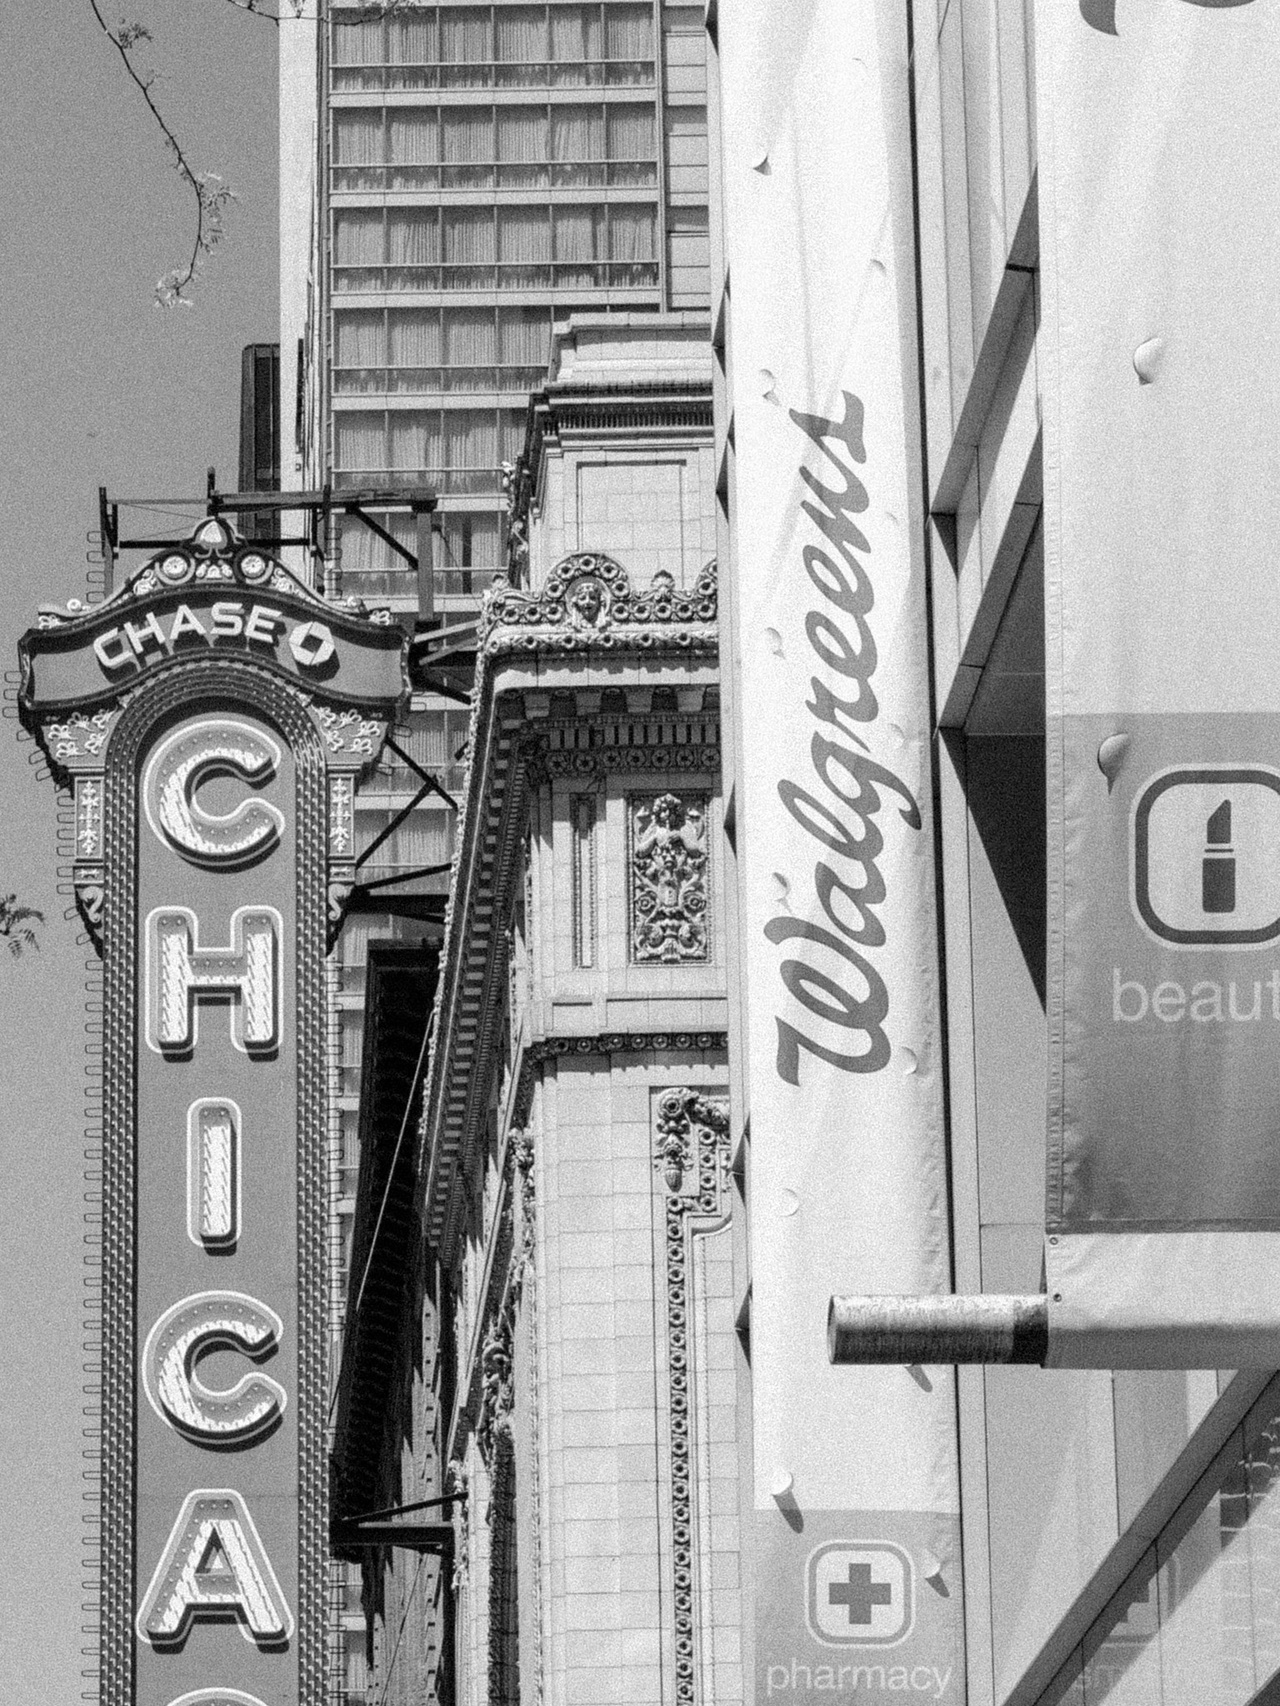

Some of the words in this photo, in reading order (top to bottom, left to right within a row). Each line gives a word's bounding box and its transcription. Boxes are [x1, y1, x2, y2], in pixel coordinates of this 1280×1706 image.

[93, 601, 282, 669] CHASE
[763, 388, 923, 1088] Walgreens
[767, 1657, 953, 1699] pharmacy
